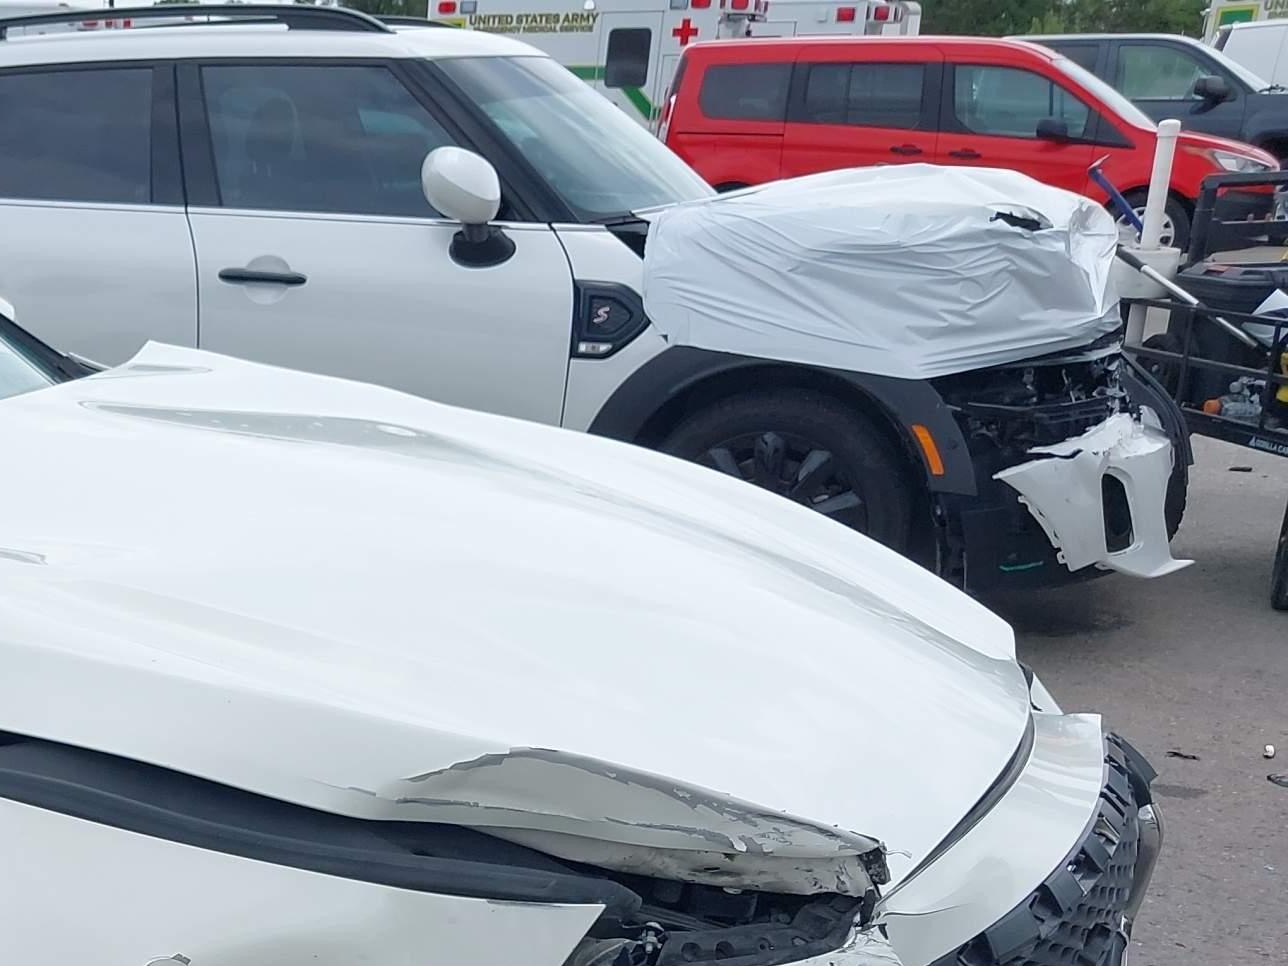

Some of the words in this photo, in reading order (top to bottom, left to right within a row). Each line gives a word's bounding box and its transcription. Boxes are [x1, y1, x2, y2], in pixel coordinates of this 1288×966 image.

[469, 14, 514, 26] UNITED
[515, 13, 560, 25] STATES
[562, 12, 599, 25] ARMY
[593, 306, 610, 323] S
